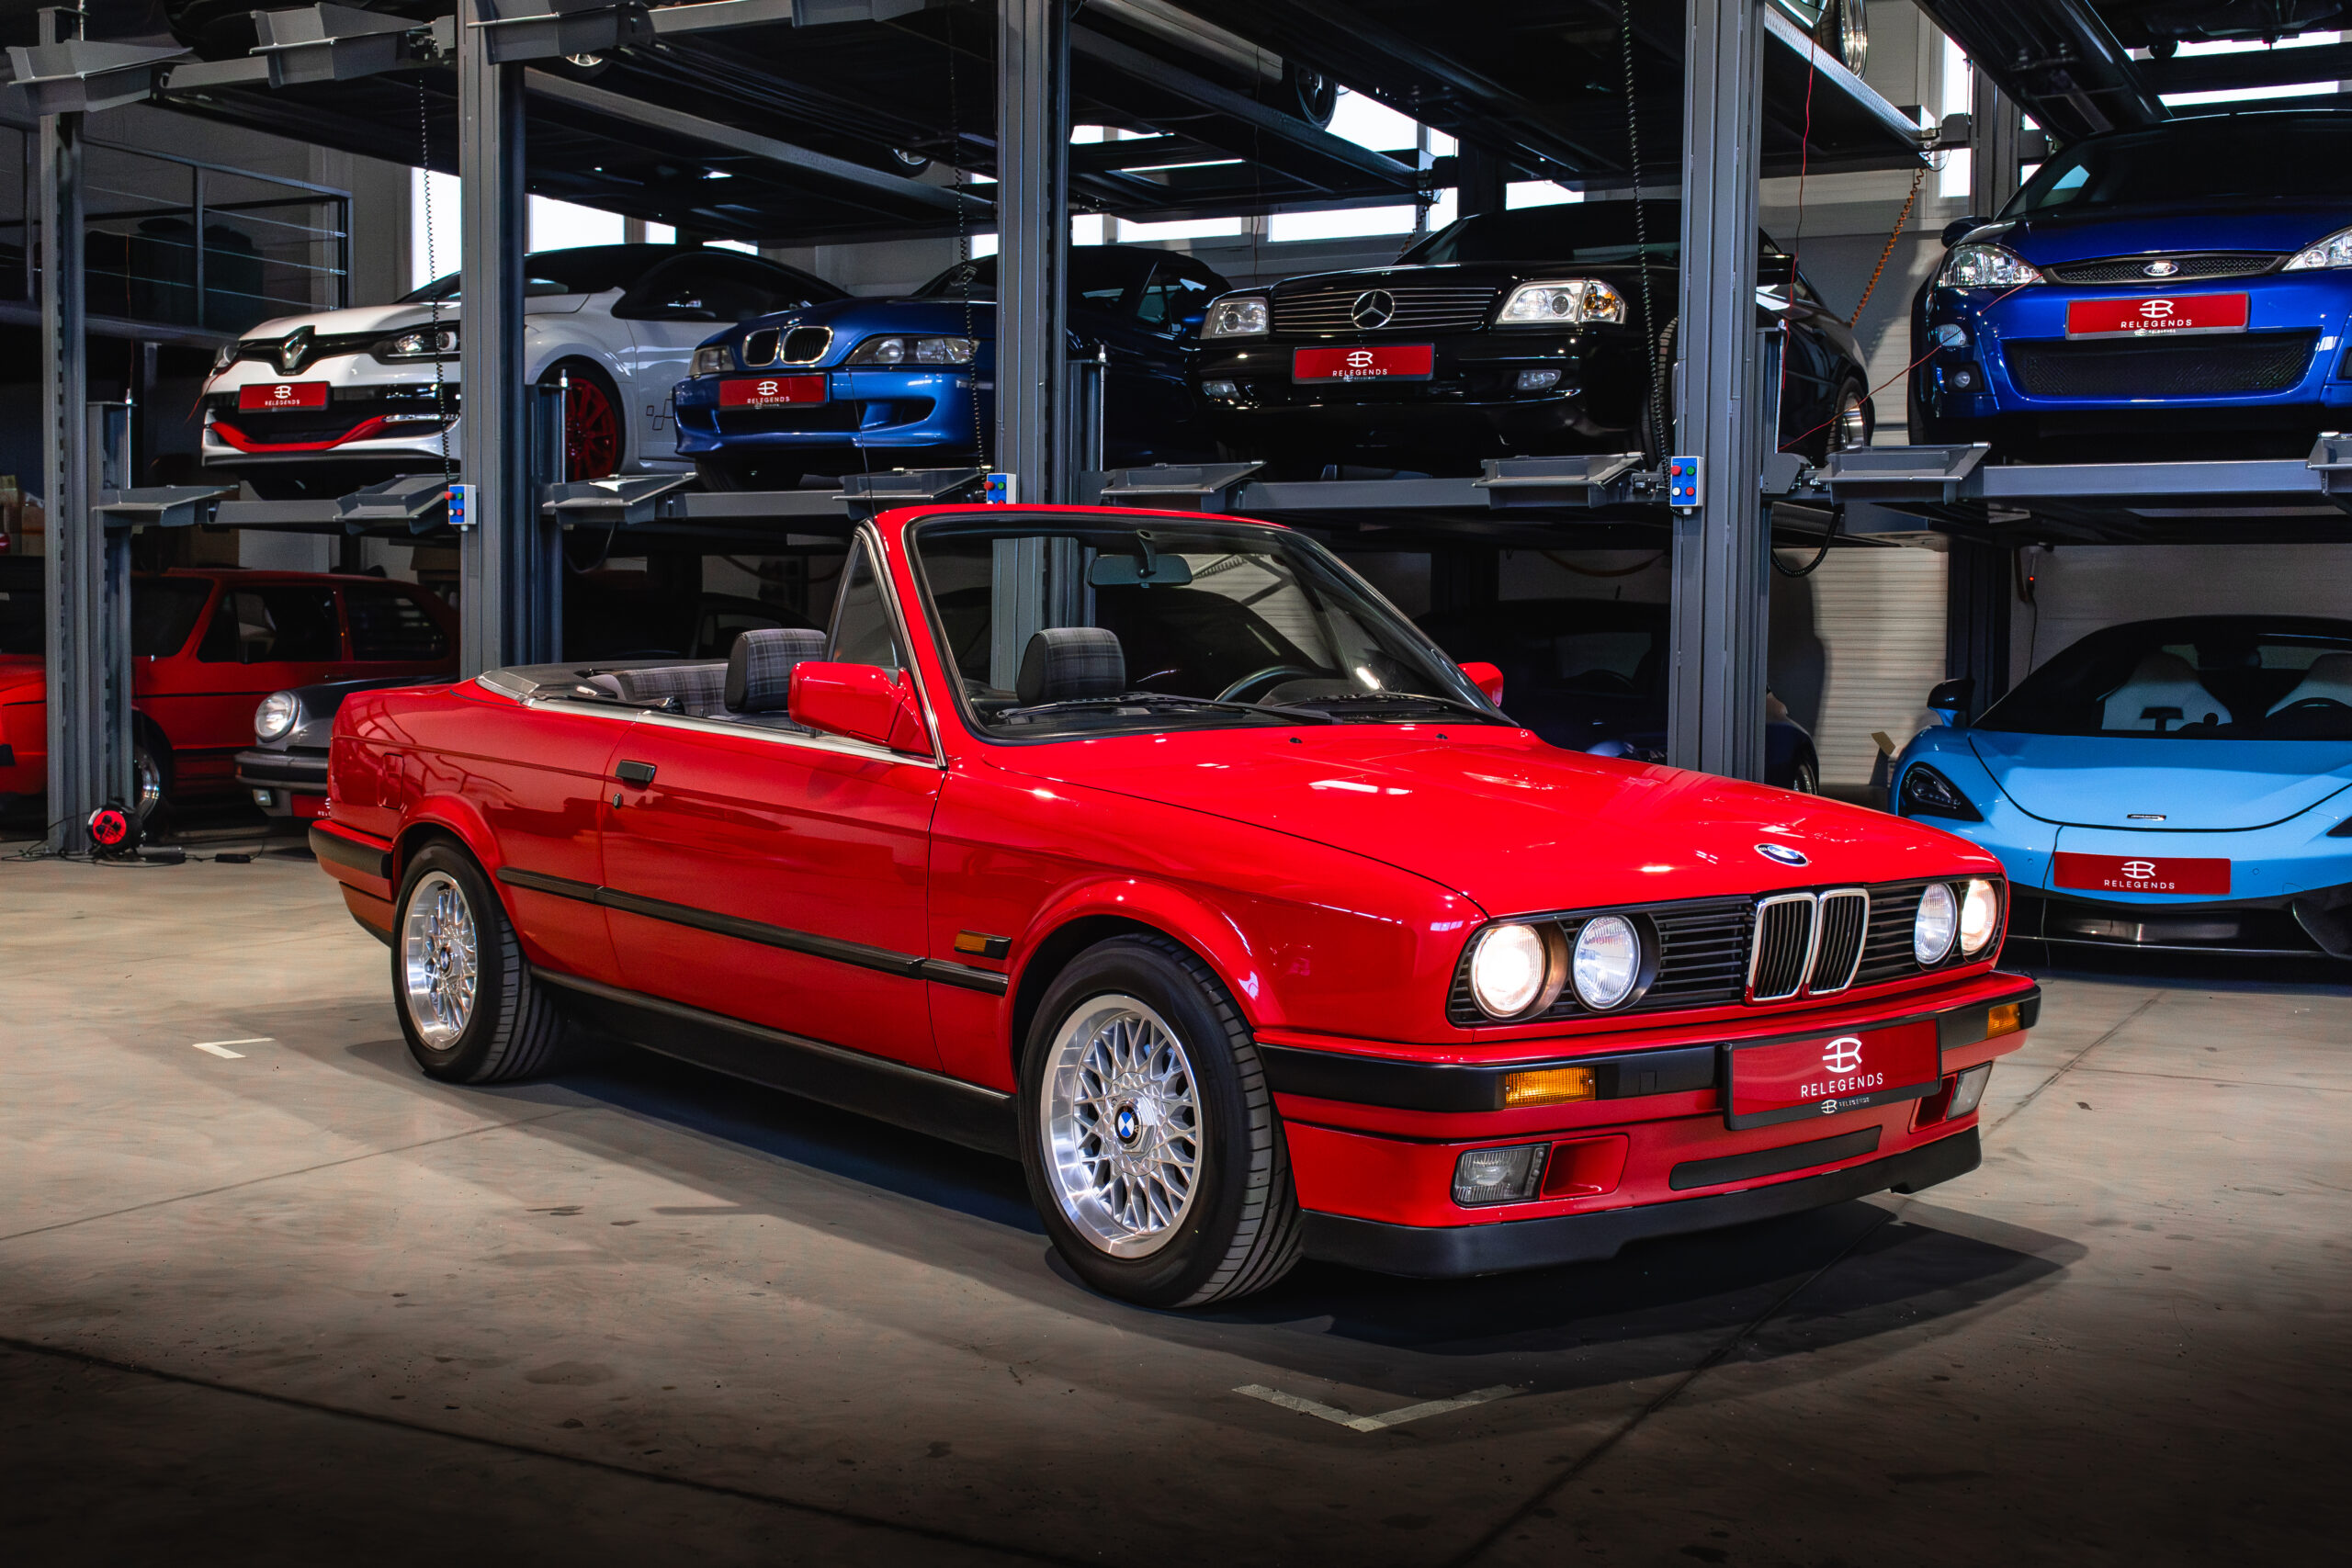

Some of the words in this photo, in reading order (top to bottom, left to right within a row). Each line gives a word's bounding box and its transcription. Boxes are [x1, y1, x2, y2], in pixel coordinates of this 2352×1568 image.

[2120, 319, 2192, 328] RELEGENDS
[1332, 368, 1387, 377] RELEGENDS
[747, 396, 790, 404] RELEGENDS
[2104, 879, 2176, 889] RELEGENDS
[1801, 1072, 1883, 1098] RELEGENDS
